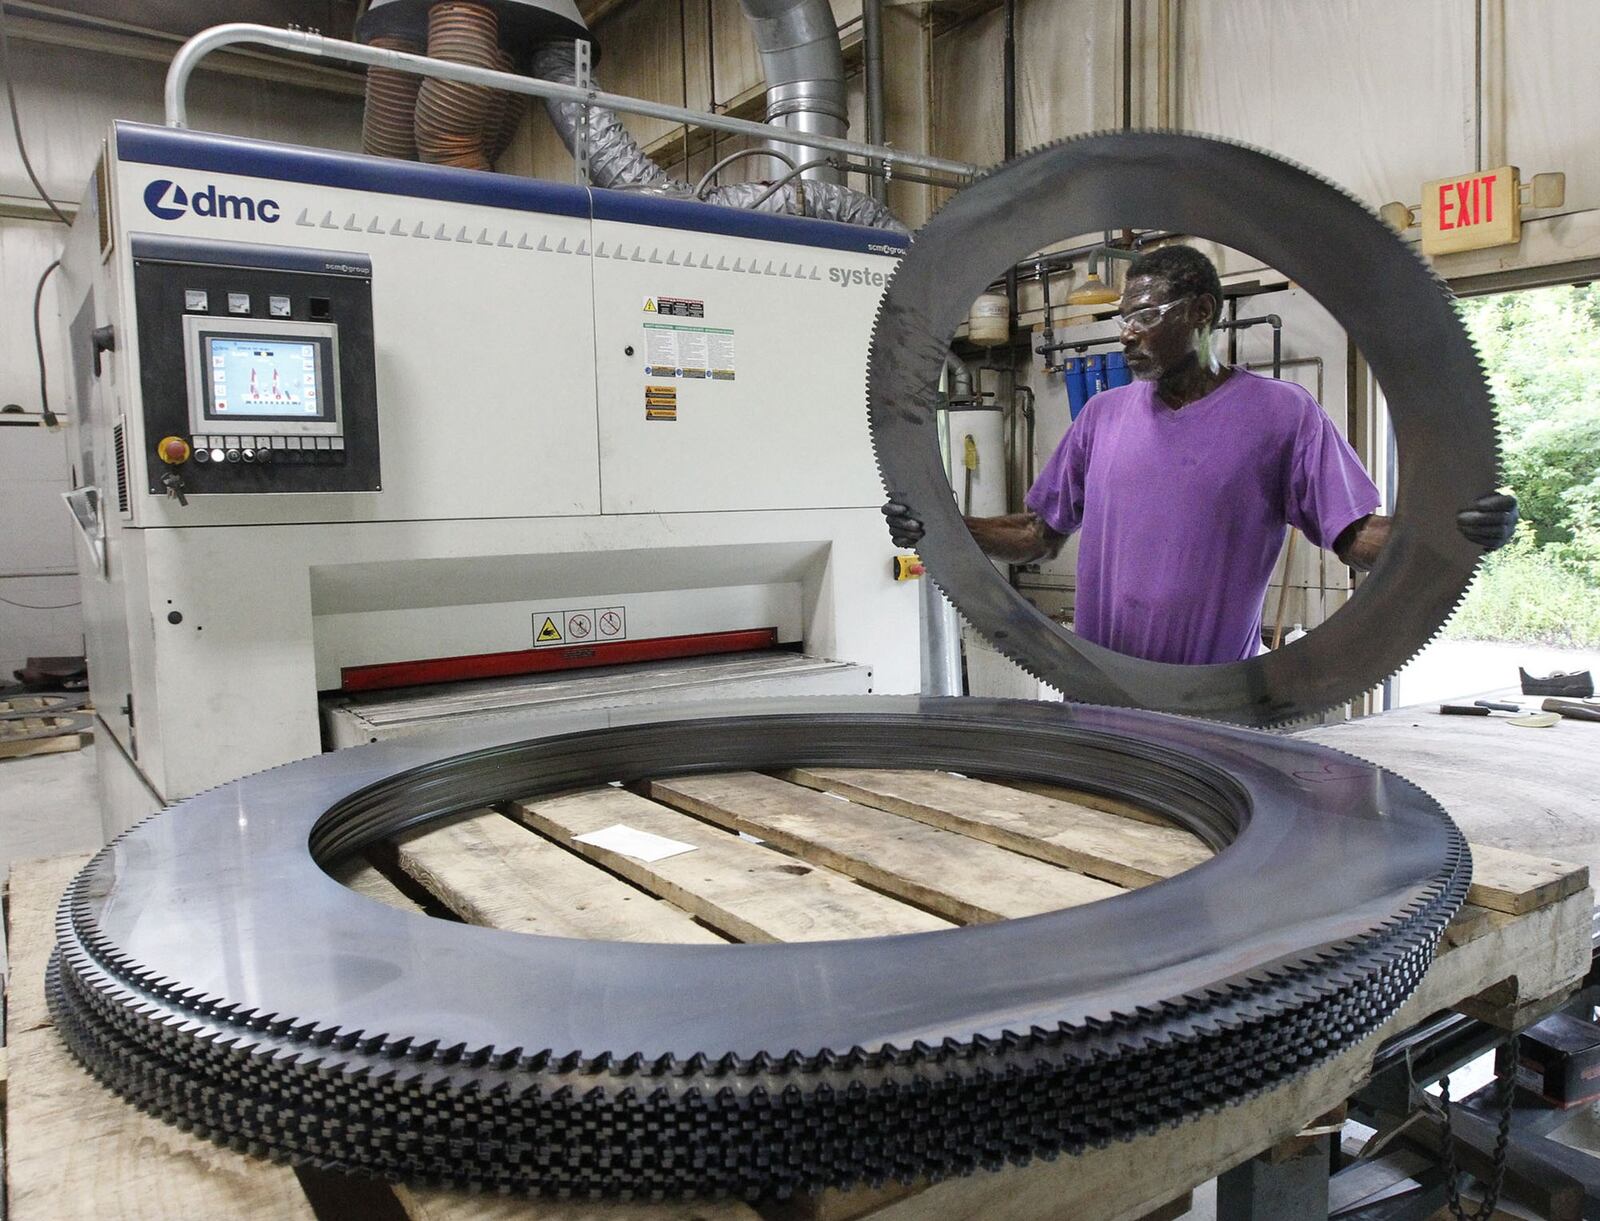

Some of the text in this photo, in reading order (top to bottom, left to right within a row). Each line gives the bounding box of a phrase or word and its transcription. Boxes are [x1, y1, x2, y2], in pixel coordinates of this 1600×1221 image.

[191, 185, 280, 223] dmc
[1439, 175, 1496, 230] EXIT
[828, 267, 890, 287] syste
